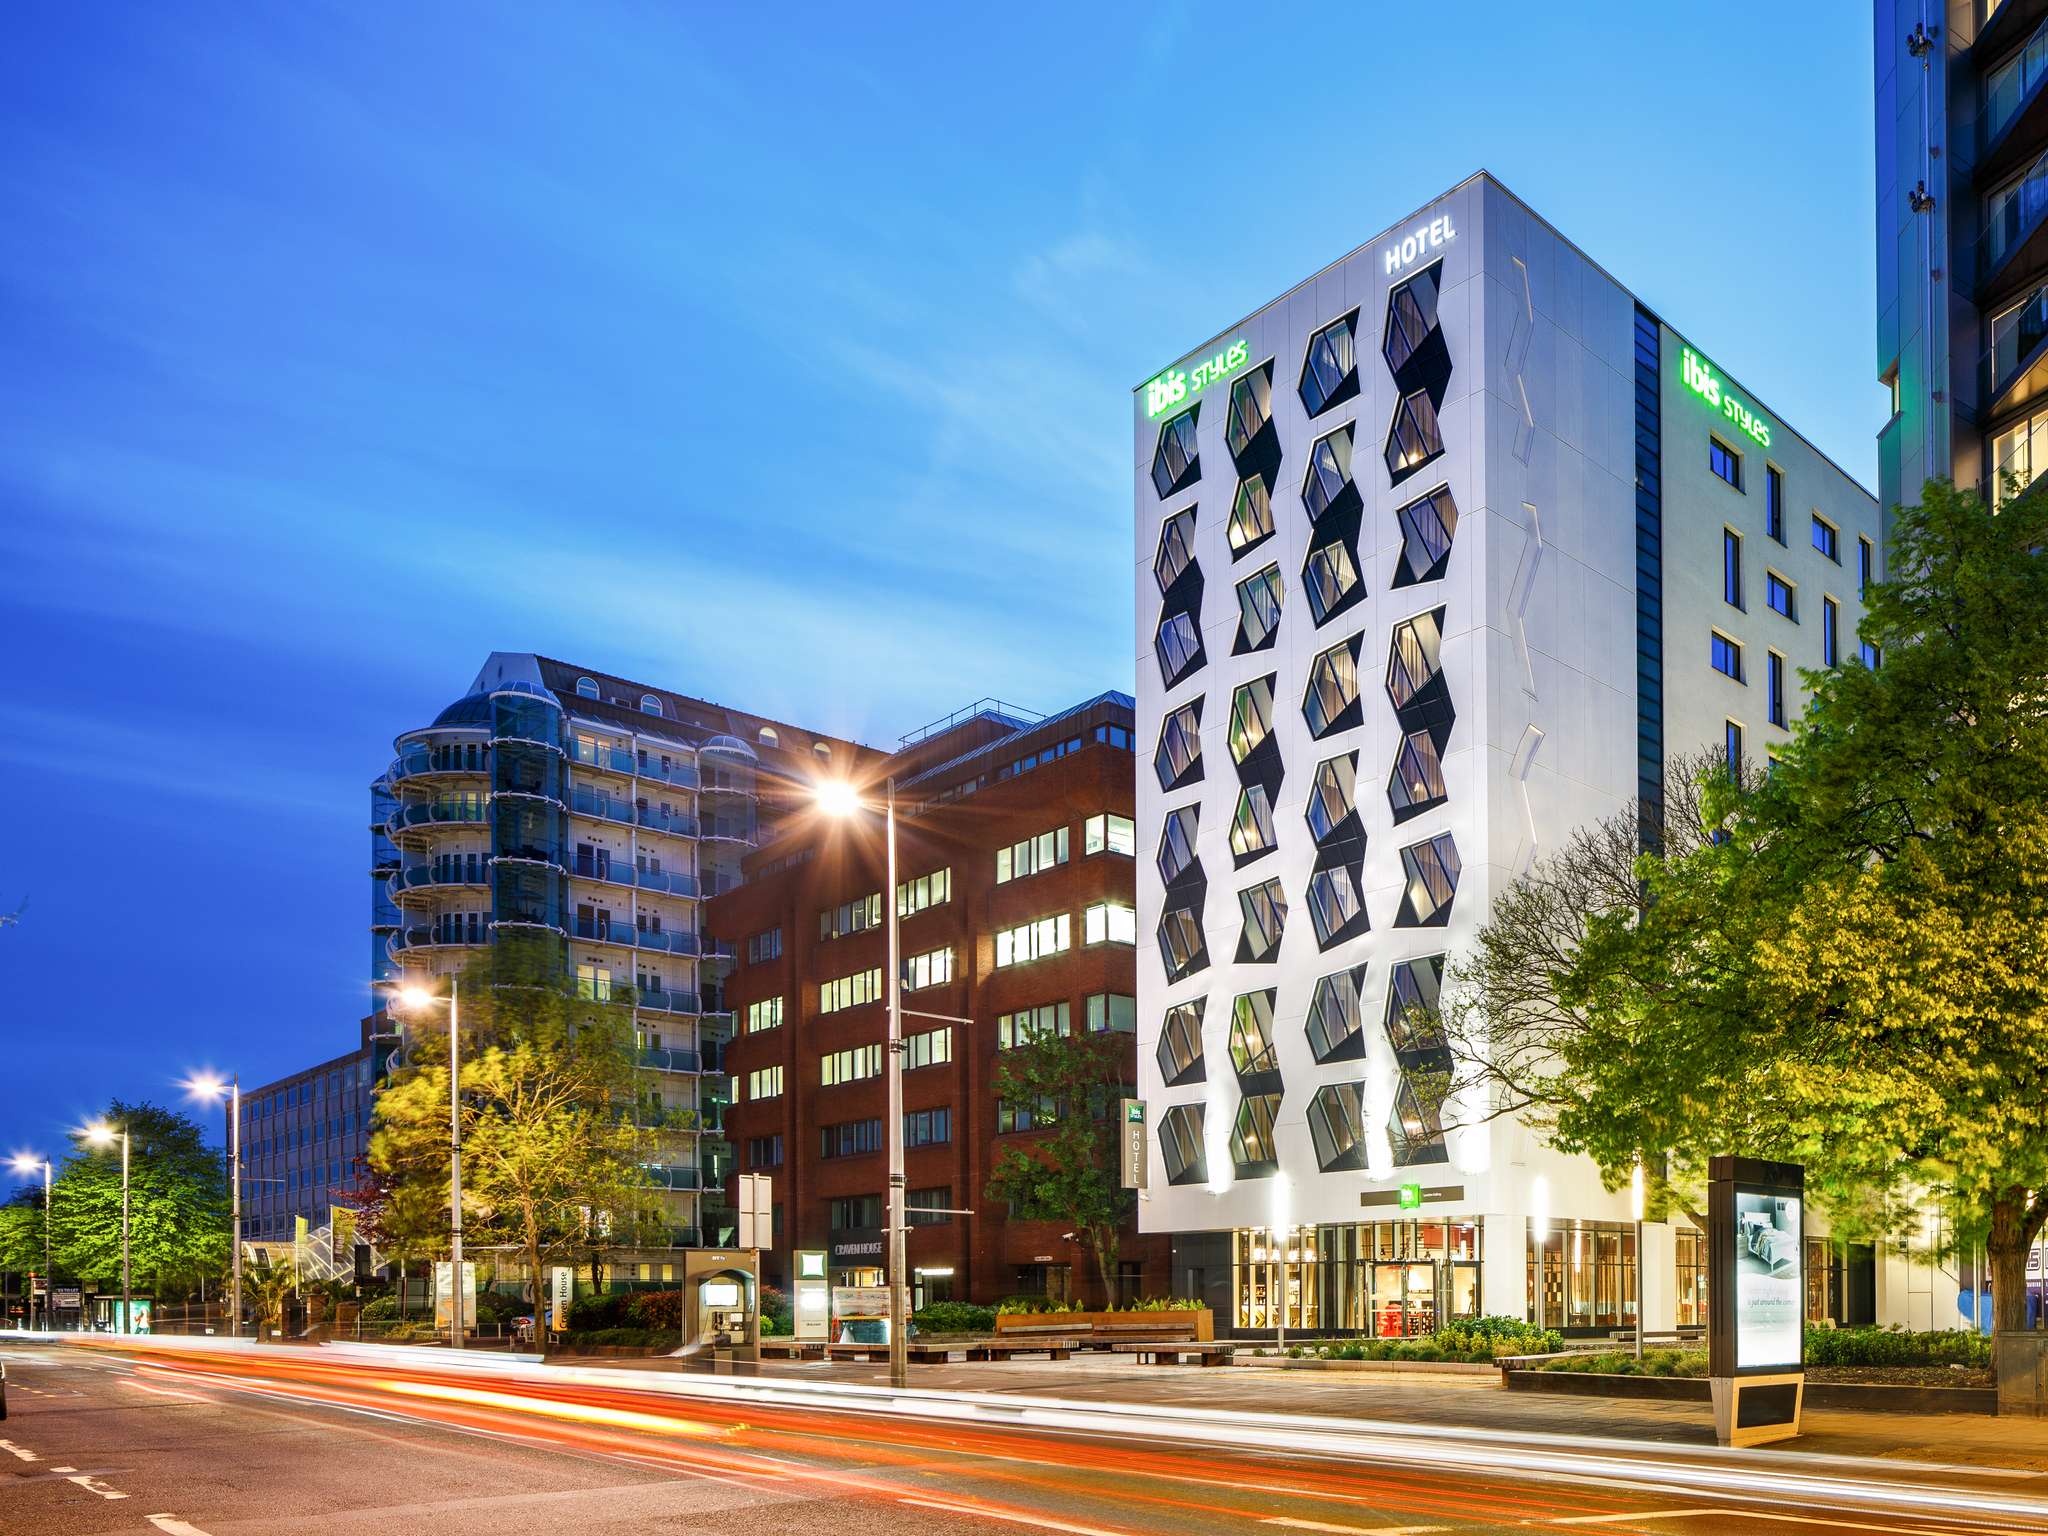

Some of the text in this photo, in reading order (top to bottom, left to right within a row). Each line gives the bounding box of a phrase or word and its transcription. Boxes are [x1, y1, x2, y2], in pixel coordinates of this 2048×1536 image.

[1385, 216, 1456, 275] HOTEL
[1147, 370, 1187, 417] ibis
[1682, 347, 1720, 407] ibis
[1132, 1130, 1140, 1184] HOTEL
[835, 1242, 883, 1256] CRAVEN HOUSE
[559, 1271, 568, 1329] Craven House
